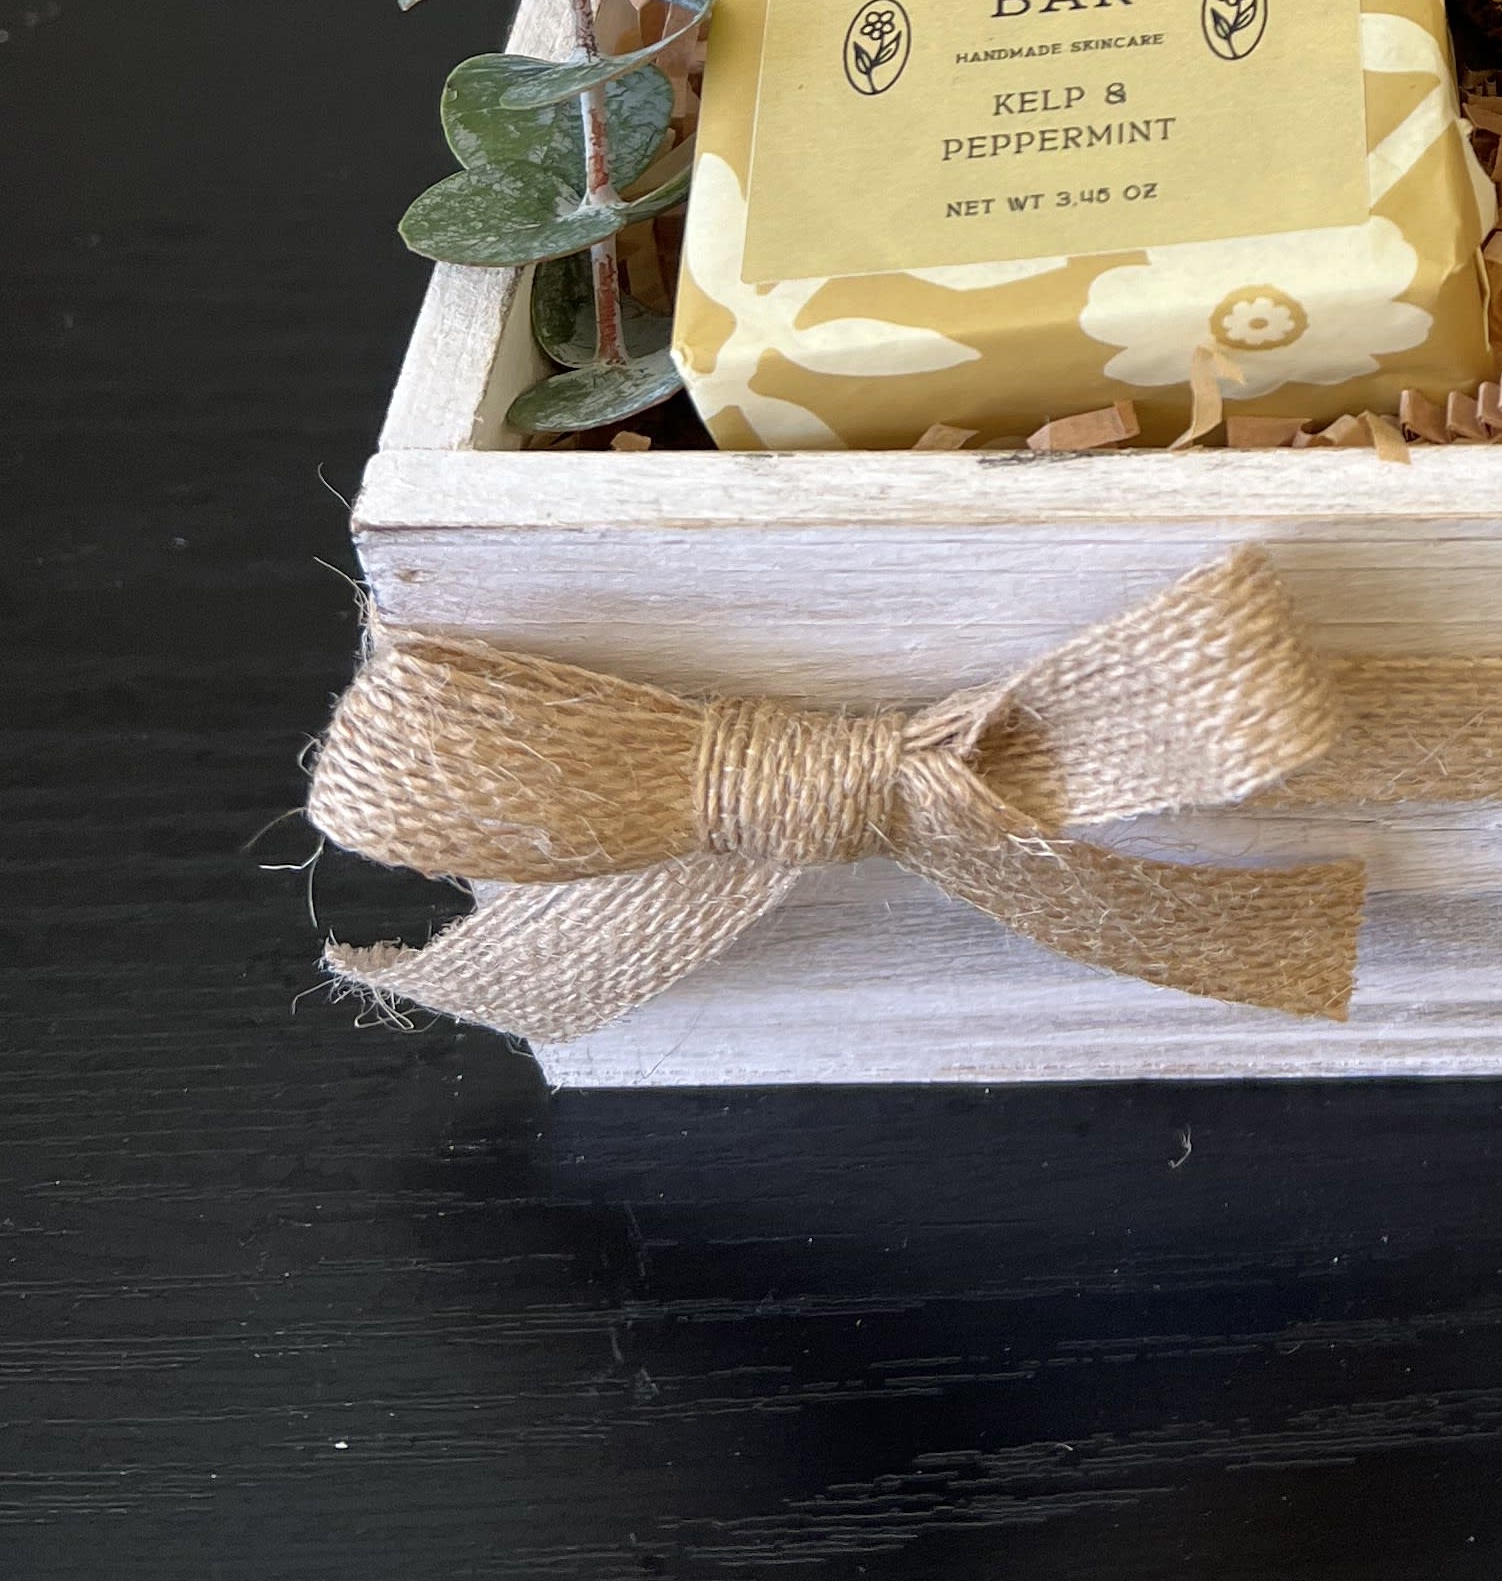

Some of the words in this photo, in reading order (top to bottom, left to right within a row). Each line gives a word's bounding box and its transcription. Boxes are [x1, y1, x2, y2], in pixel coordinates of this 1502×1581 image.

[955, 42, 1063, 65] HANDMADE
[1070, 32, 1164, 53] SKINCARE
[993, 85, 1086, 116] KELP
[1104, 81, 1127, 105] &
[941, 117, 1177, 161] PEPPERMINT
[946, 198, 995, 218] NET
[1008, 194, 1045, 212] WT
[1122, 182, 1158, 201] OZ
